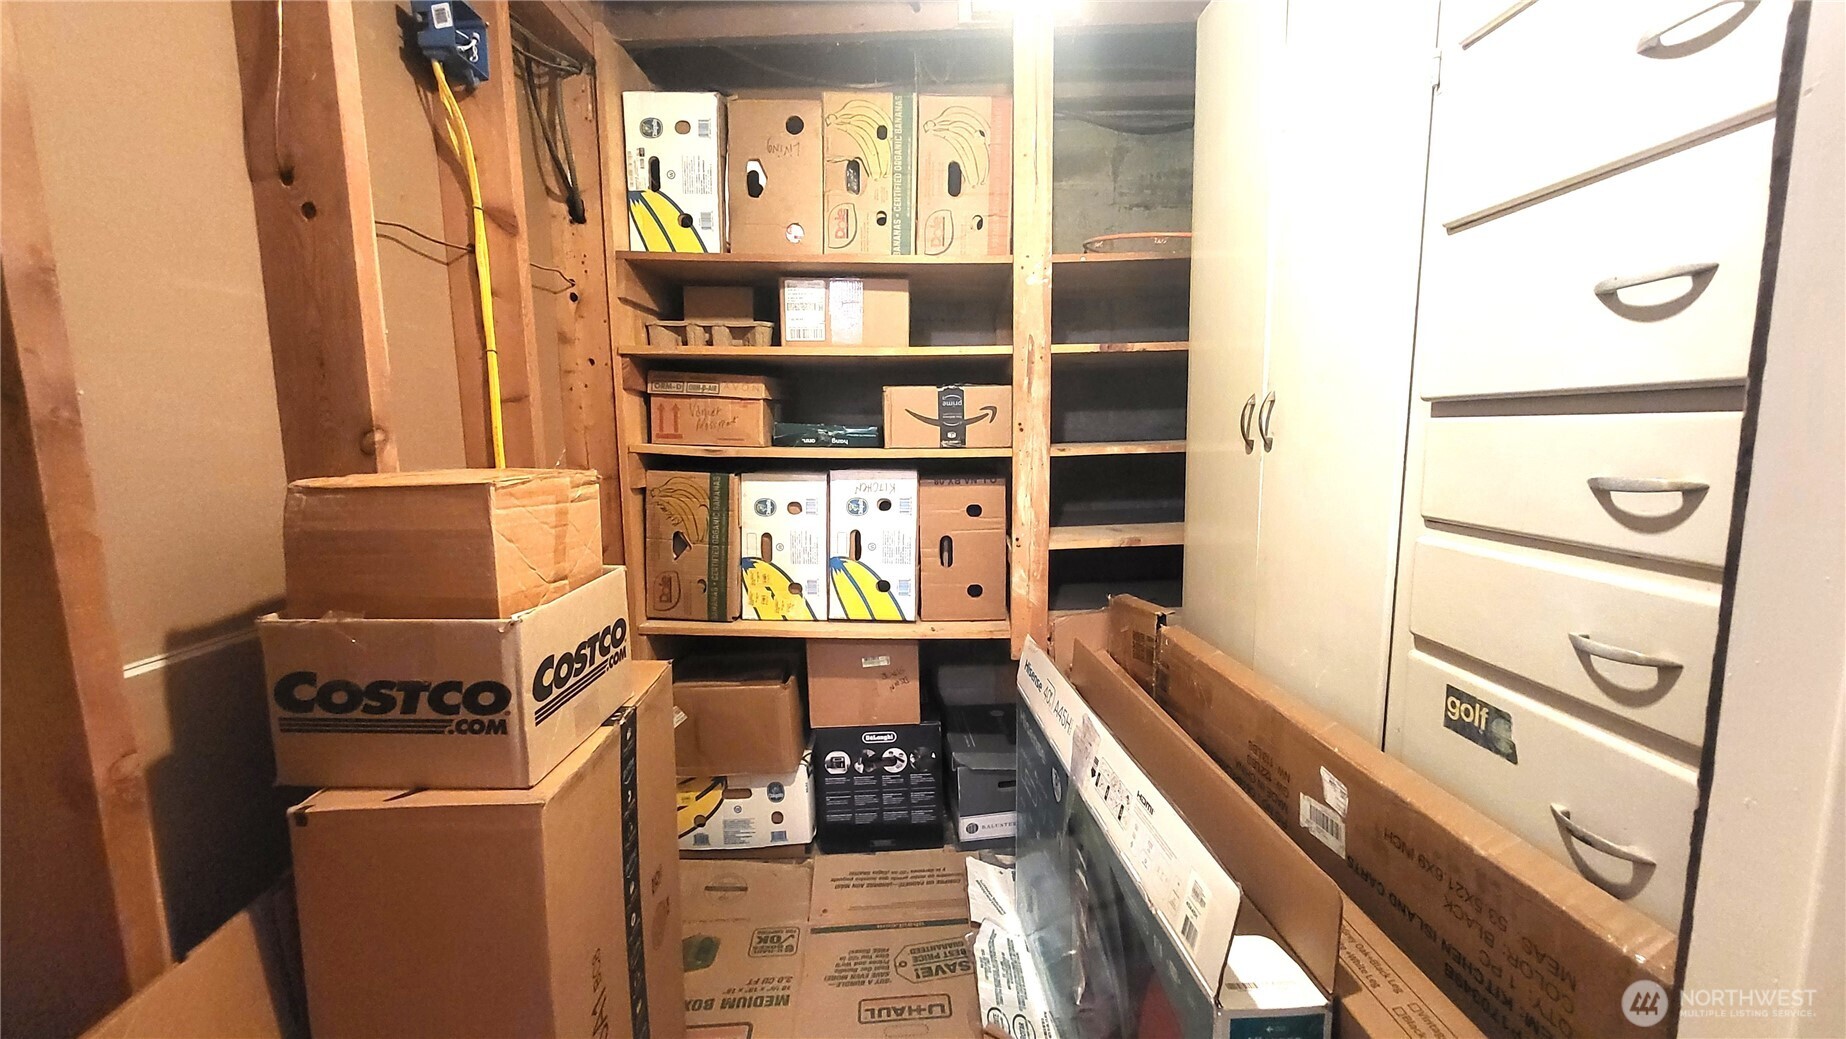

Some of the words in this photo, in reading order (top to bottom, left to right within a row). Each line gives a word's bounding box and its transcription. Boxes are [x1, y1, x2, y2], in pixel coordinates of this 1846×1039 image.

[894, 95, 903, 134] BANANAS
[893, 136, 902, 171] ORGANIC
[893, 174, 902, 212] CERTIFIED
[942, 399, 962, 407] prime
[712, 476, 721, 511] BANANAS
[711, 513, 720, 544] ORGANIC
[711, 545, 719, 581] CERTIFIED
[532, 617, 627, 702] COSTCO
[606, 646, 627, 672] .COM
[1024, 659, 1043, 692] Hisense
[273, 671, 512, 716] COSTCO
[449, 719, 508, 735] .COM
[1447, 696, 1489, 730] golf
[1137, 790, 1155, 816] HDMI
[1347, 856, 1386, 897] CARTS
[1389, 892, 1437, 943] ISLAND
[1444, 895, 1495, 949] BLACK
[757, 934, 782, 945] OK
[942, 948, 966, 960] BEST
[912, 951, 940, 963] PRICE
[914, 959, 971, 979] SAVE!
[1479, 950, 1503, 979] PC
[1365, 974, 1380, 989] Leg
[1388, 979, 1404, 994] Leg
[1440, 938, 1513, 1011] KITCHEN
[719, 994, 790, 1010] MEDIUM
[864, 1003, 946, 1019] U-HAUL
